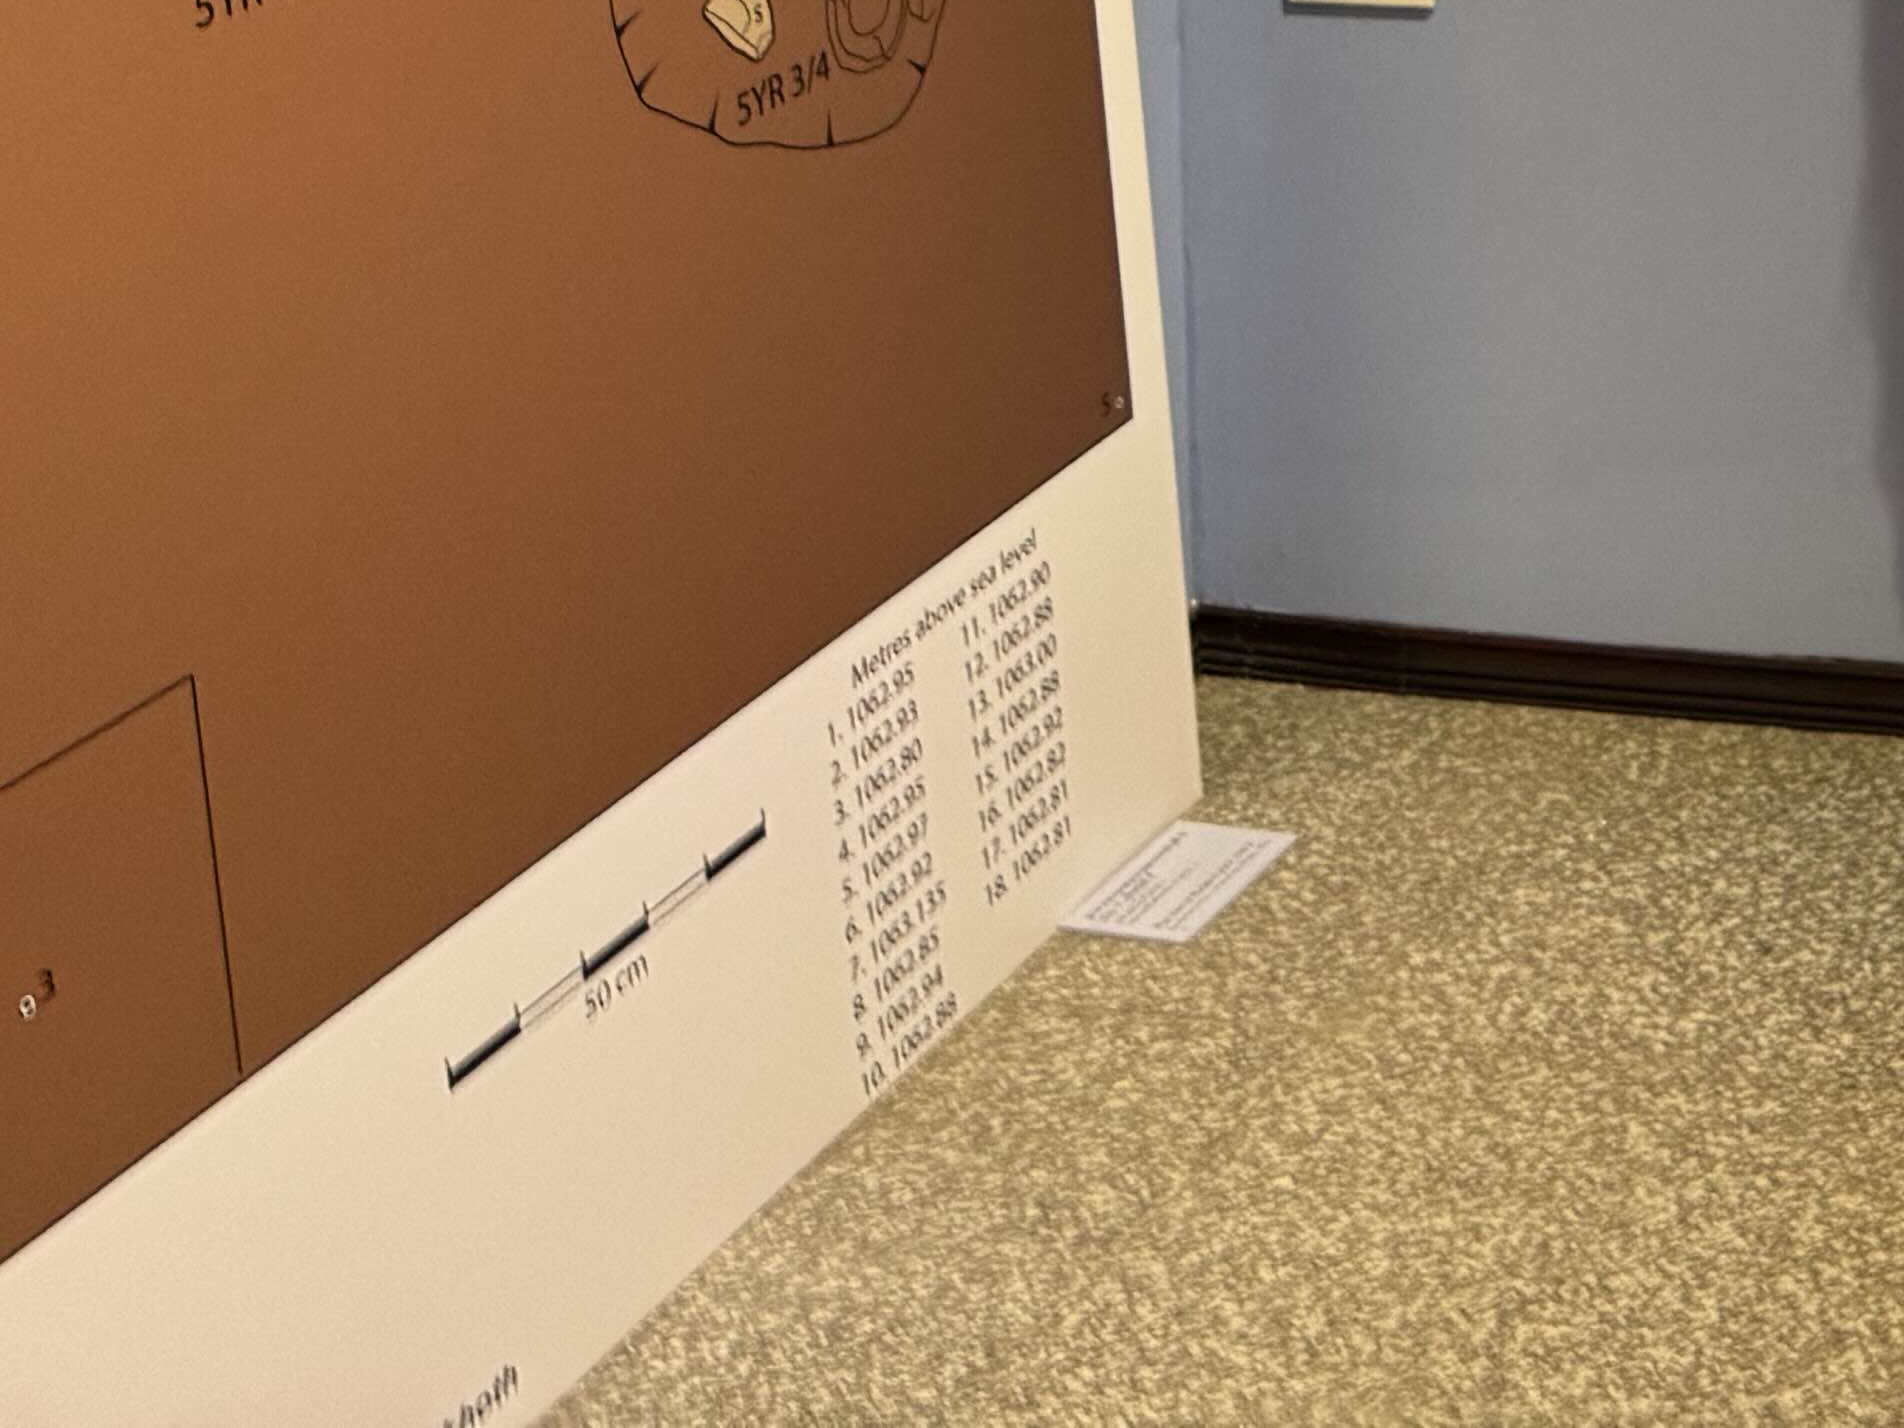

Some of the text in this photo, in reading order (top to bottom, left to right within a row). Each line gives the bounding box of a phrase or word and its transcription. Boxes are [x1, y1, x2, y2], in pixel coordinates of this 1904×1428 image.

[737, 50, 830, 126] 5YR 3/4
[849, 528, 1039, 690] Metres above sea level
[583, 952, 648, 1018] 50 cm
